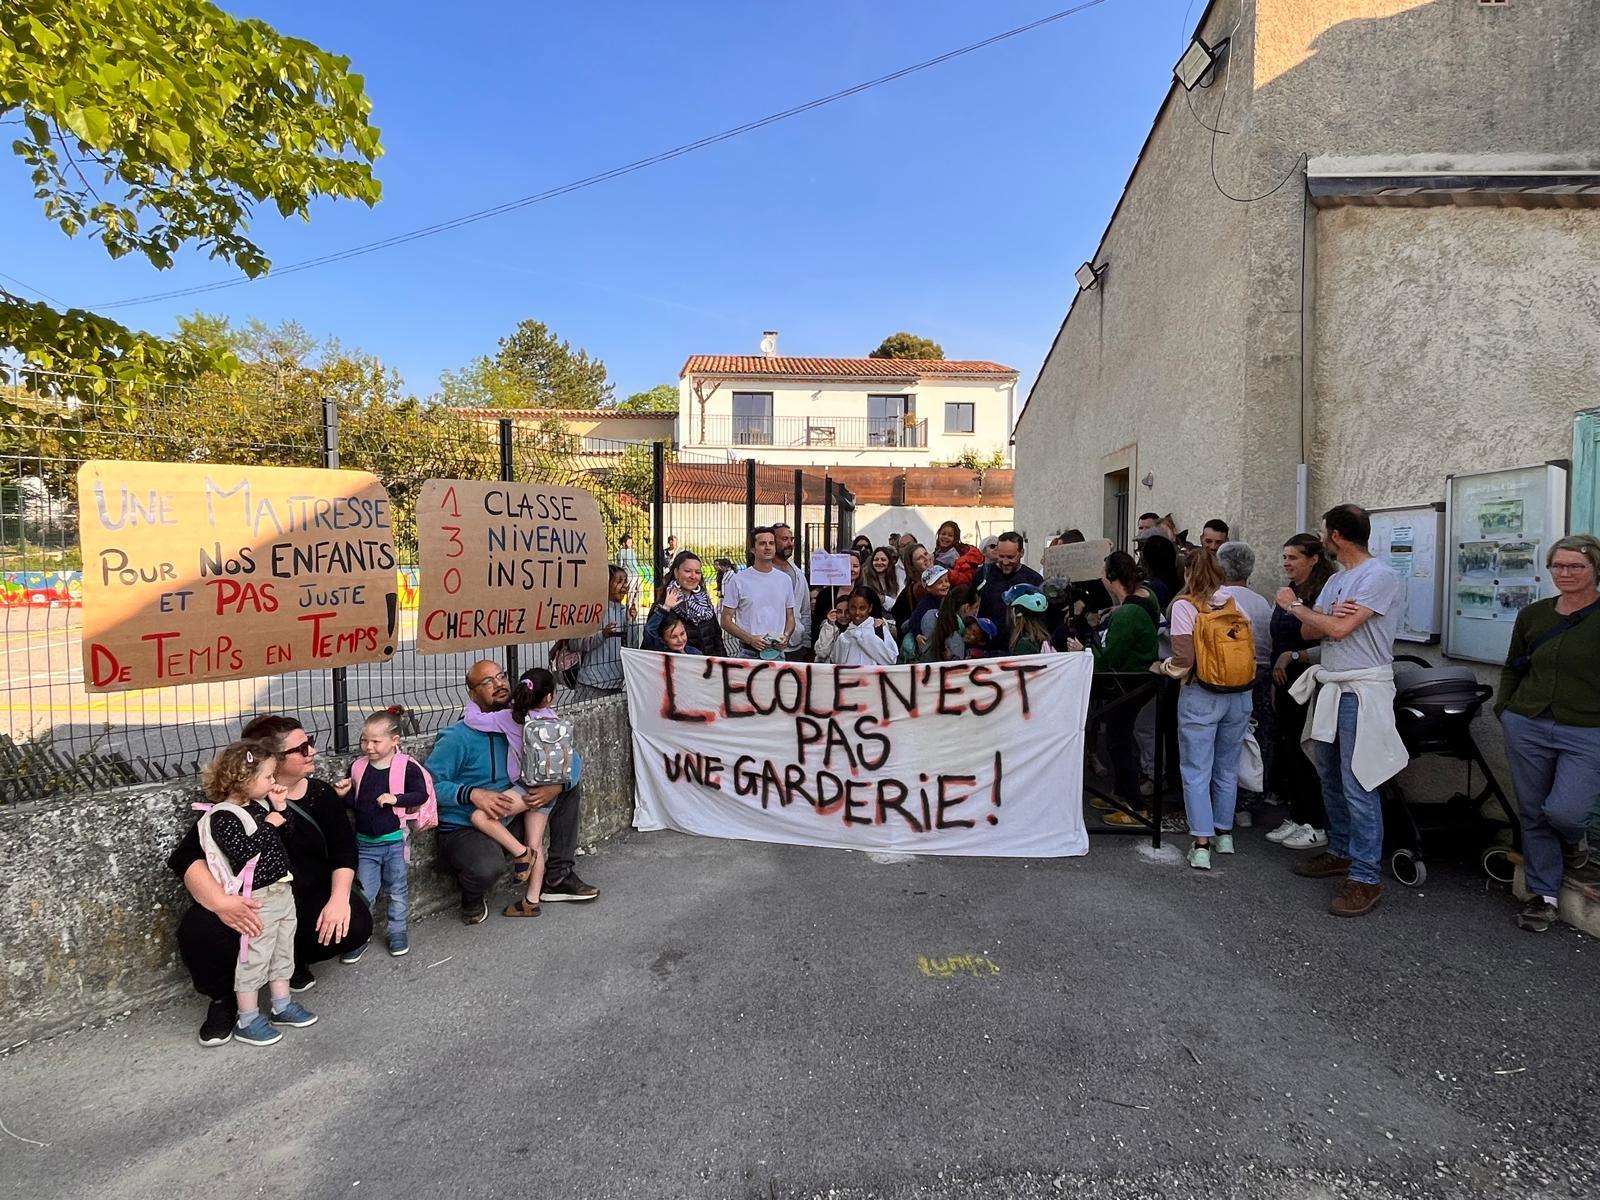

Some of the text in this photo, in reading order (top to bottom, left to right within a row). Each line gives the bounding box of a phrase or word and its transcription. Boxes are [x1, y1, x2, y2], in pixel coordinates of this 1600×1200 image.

[94, 480, 178, 530] UNE
[441, 486, 577, 521] 1 CLASSE
[99, 540, 395, 586] POUR NOS ENFANTS
[441, 526, 464, 557] 3
[160, 579, 366, 616] ET PAS JUSTE
[443, 567, 462, 594] 0
[424, 597, 603, 641] CHERCHEZ L'ERREUR
[91, 643, 132, 687] DE
[142, 632, 243, 678] TEMPS
[266, 643, 292, 665] EN
[661, 654, 1048, 724] L'ECOLE N'EST
[795, 716, 891, 772] PAS
[663, 752, 725, 790] UNE
